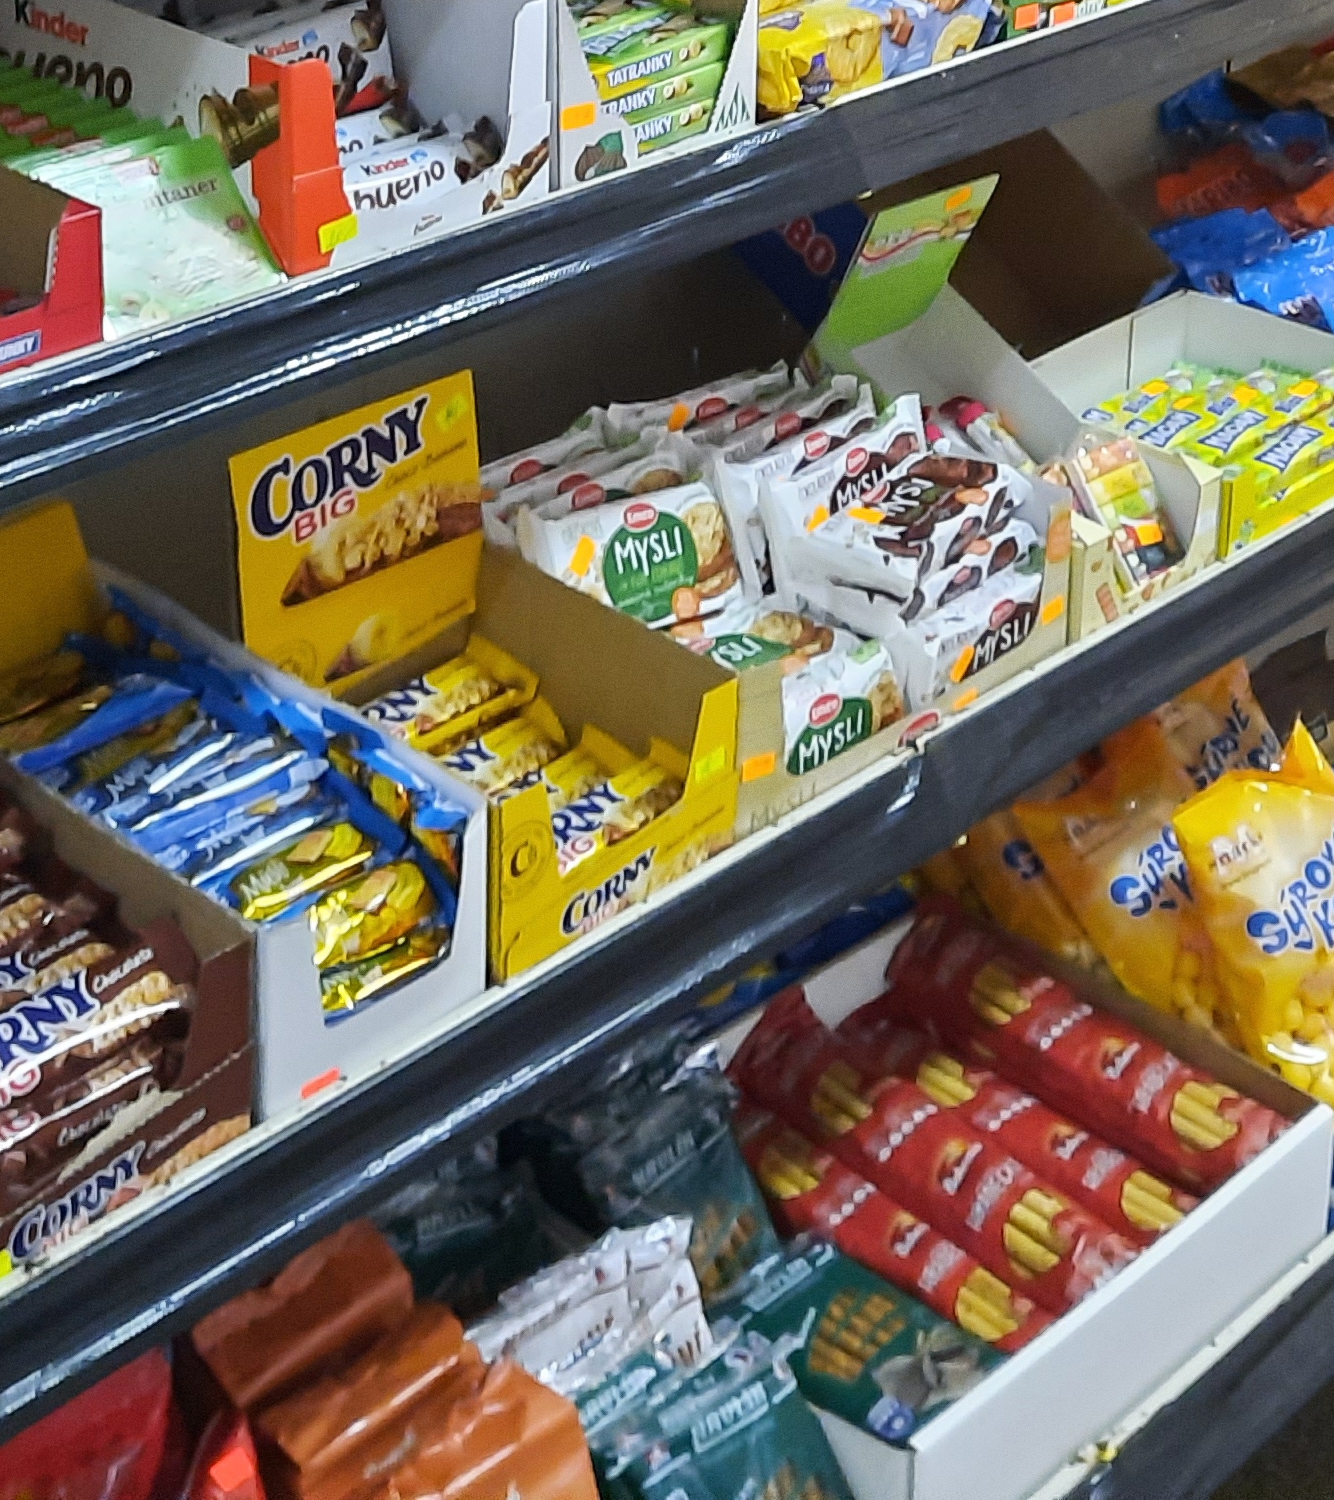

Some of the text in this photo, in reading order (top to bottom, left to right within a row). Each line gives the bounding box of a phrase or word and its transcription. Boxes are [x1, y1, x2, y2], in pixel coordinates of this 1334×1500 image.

[608, 50, 673, 87] TATRANKY
[354, 158, 446, 213] bueno
[1203, 412, 1266, 450] MAOAM
[1259, 428, 1322, 470] MAOAM
[250, 394, 430, 538] CORNY
[292, 490, 358, 545] BIG
[615, 526, 684, 582] MYSLI
[799, 708, 864, 772] MYSLI
[561, 845, 656, 936] CORNY
[92, 948, 153, 992] Chocolate
[10, 1142, 144, 1261] CORNY
